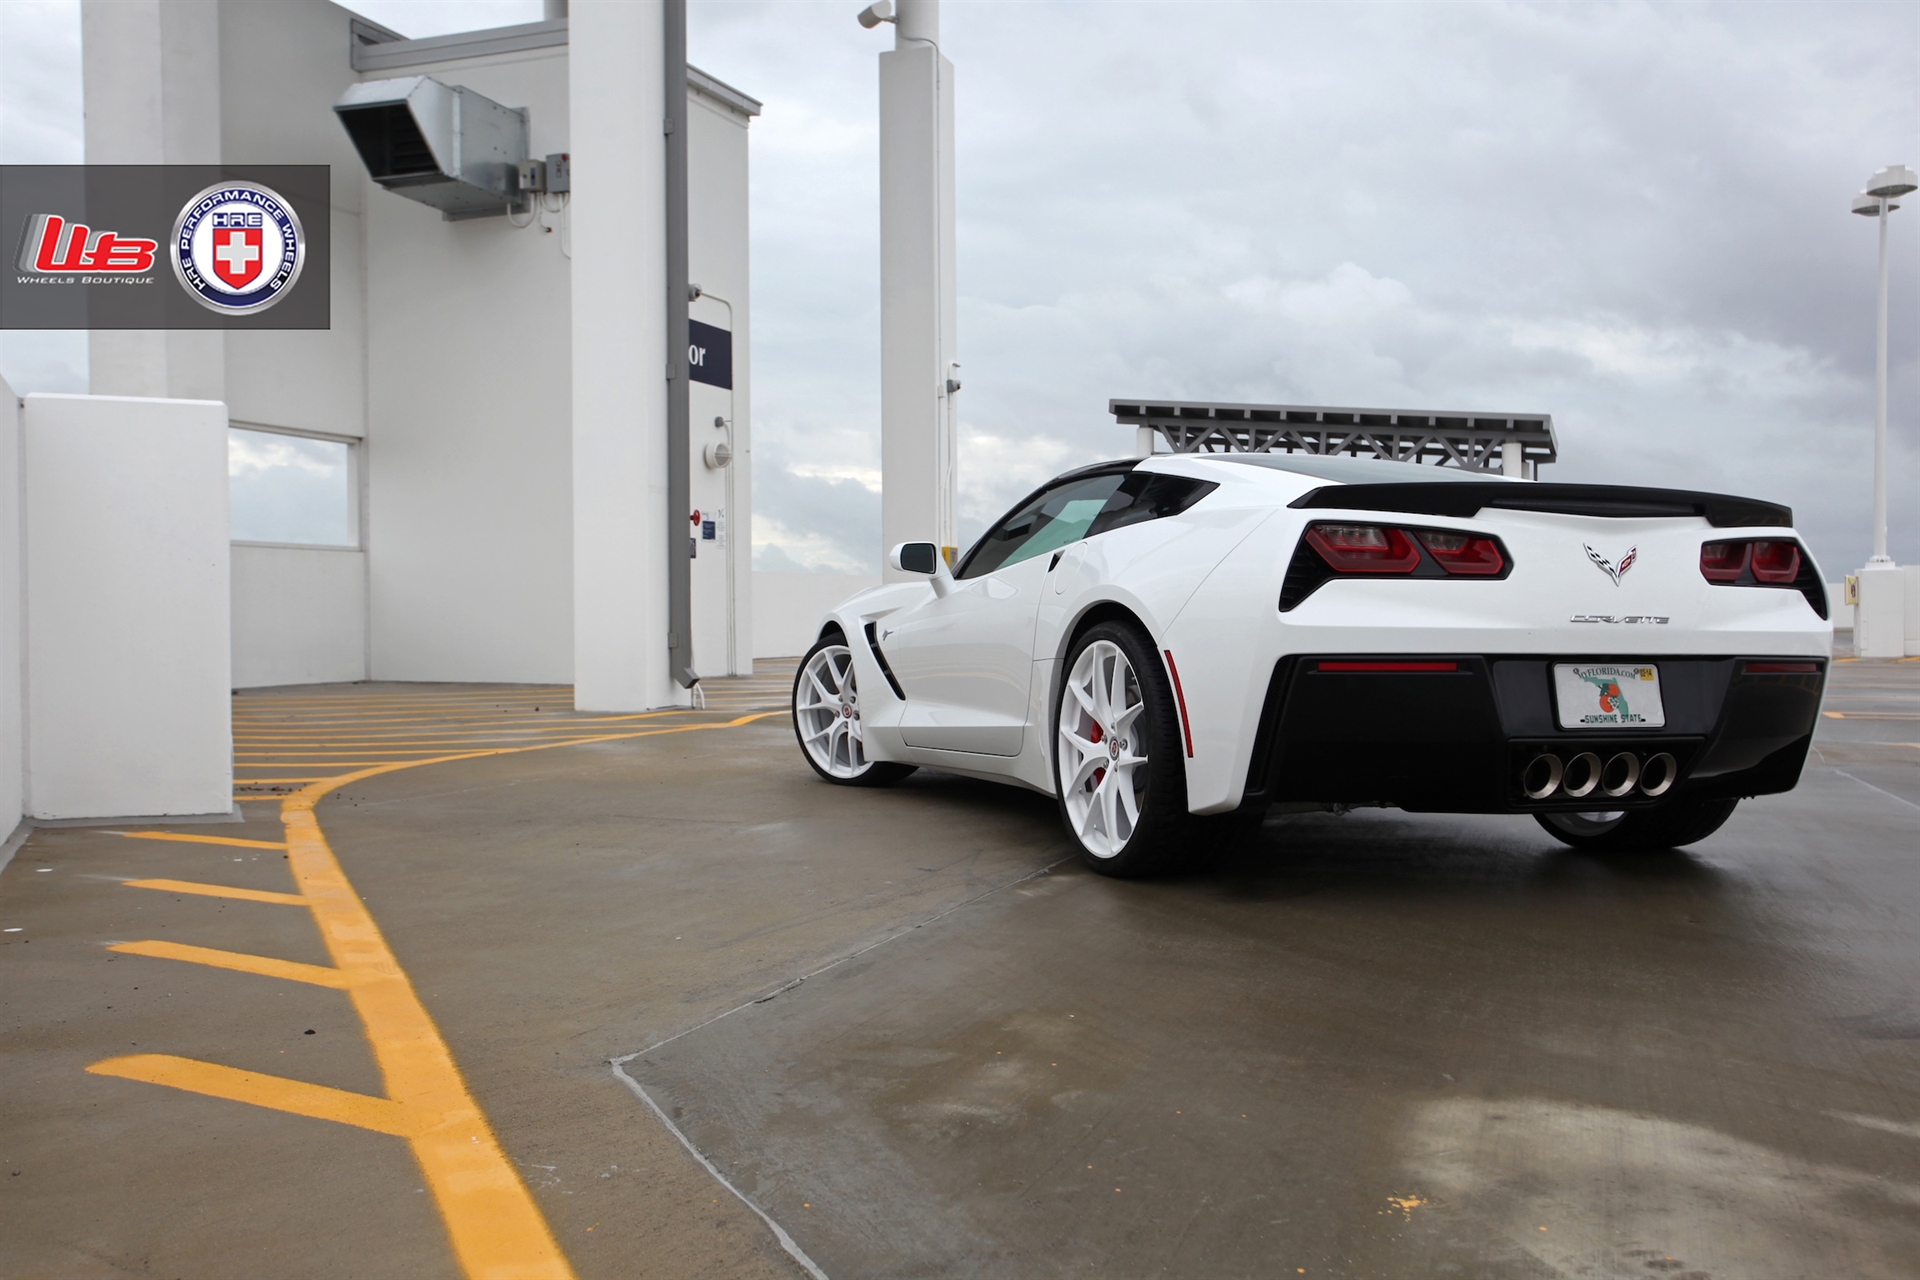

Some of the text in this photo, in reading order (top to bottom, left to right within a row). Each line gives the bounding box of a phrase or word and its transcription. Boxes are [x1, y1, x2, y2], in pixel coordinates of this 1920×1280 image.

[1570, 615, 1670, 624] CORVETTE
[1578, 667, 1636, 680] MYFLORIDA.COM
[1584, 714, 1642, 724] SUNSHINE STATE
